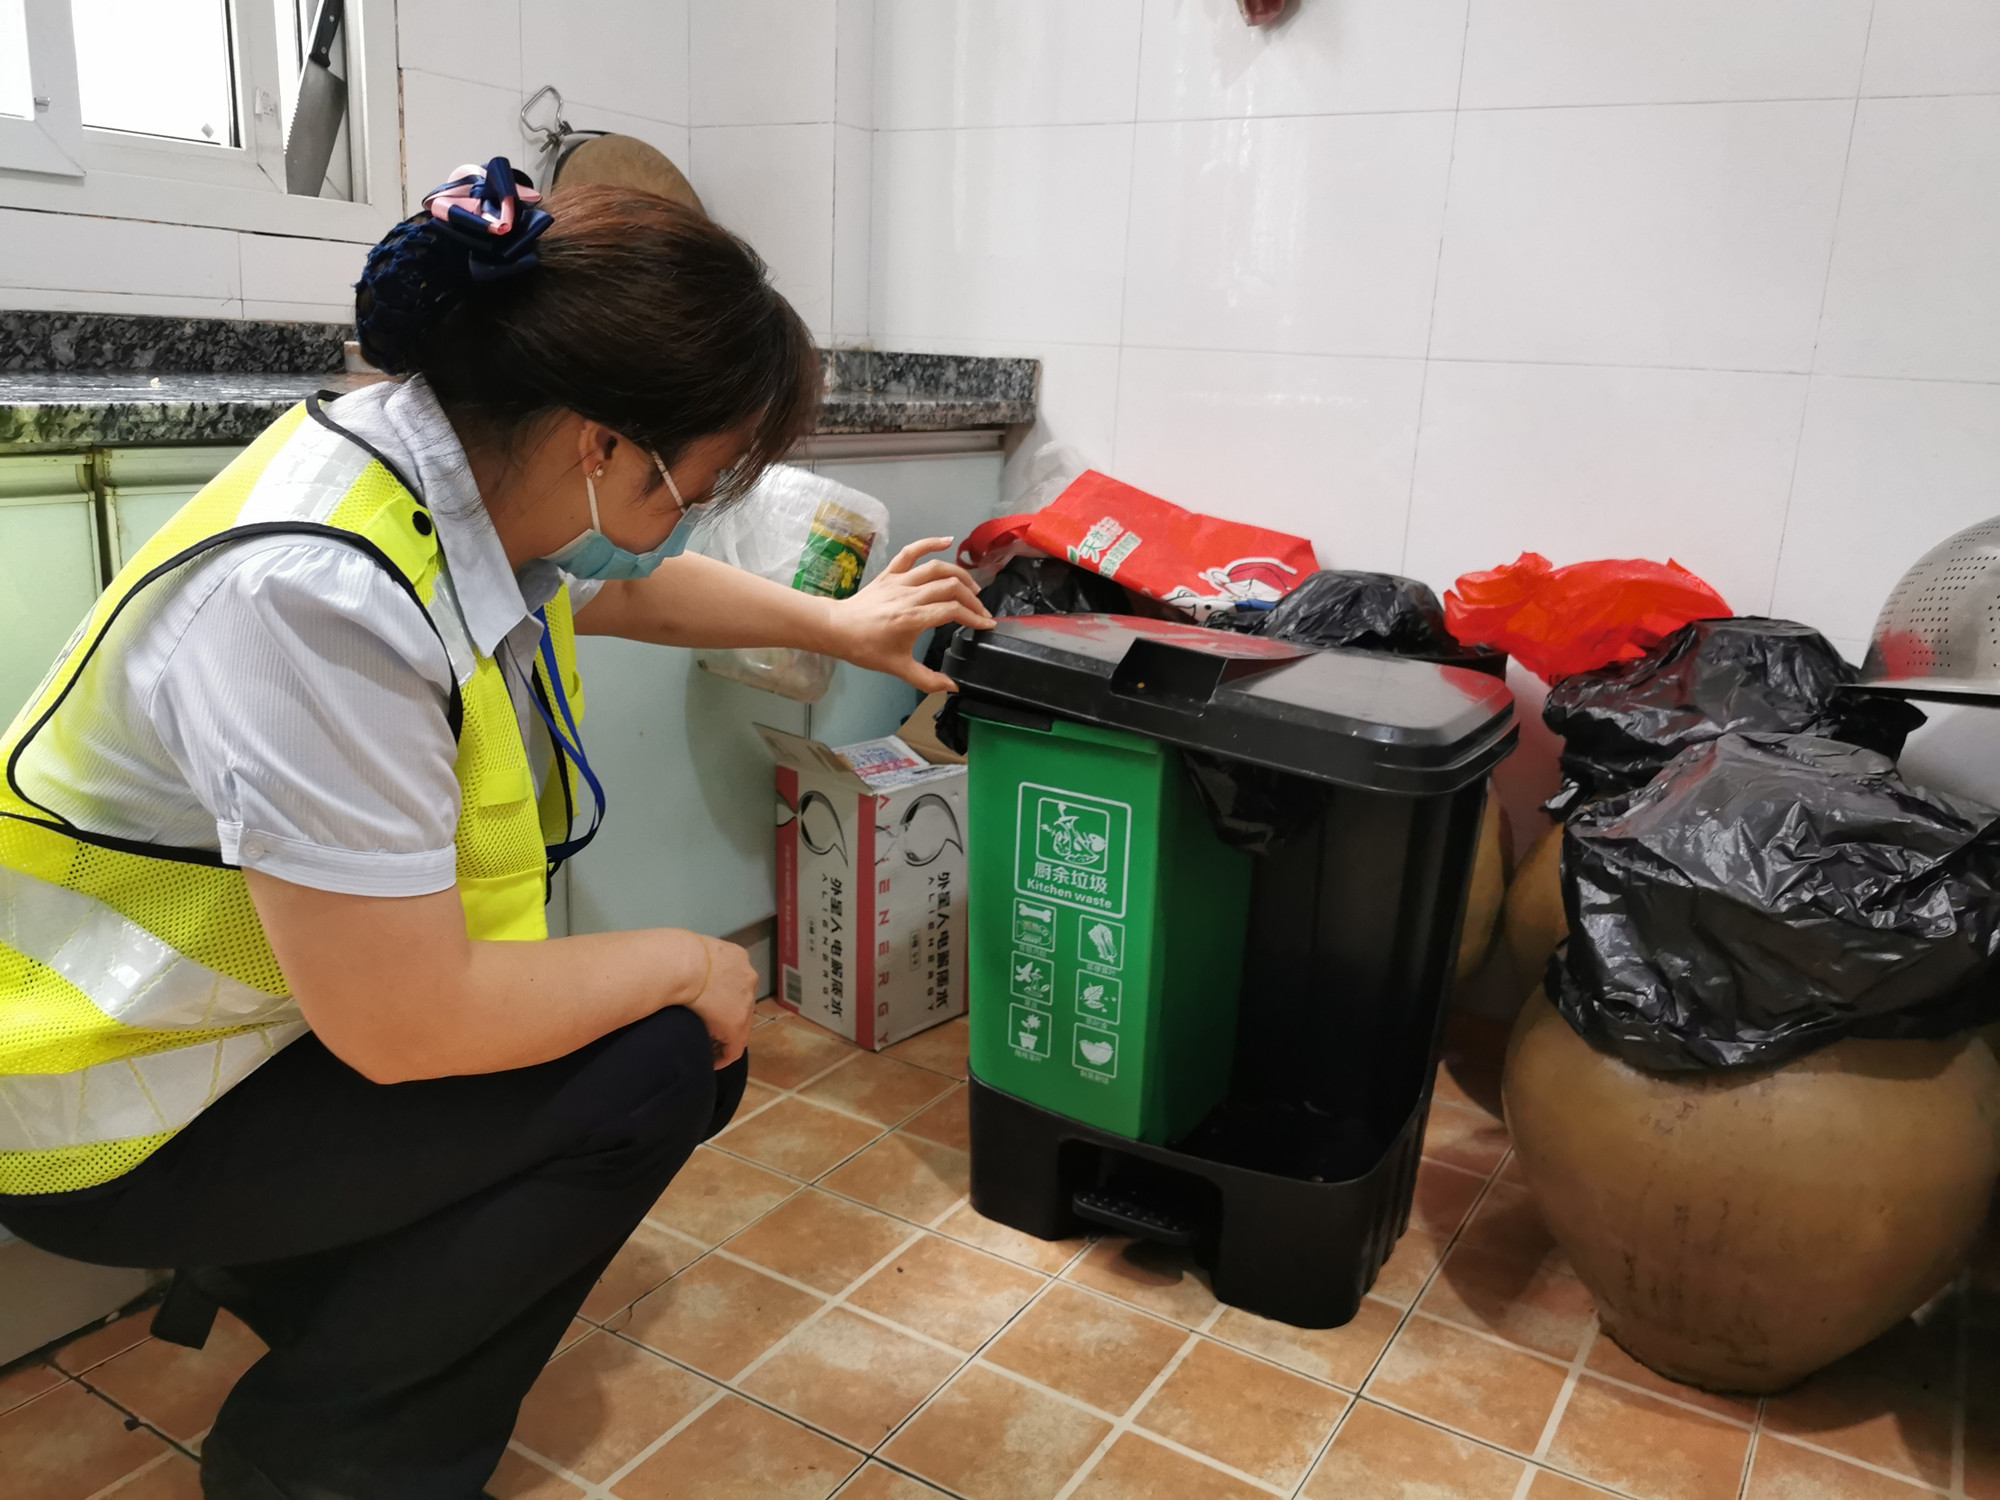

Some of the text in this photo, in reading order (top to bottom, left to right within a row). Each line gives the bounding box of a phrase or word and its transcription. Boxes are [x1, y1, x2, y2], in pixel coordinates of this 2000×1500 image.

[1026, 878, 1112, 909] Kitchen waste
[1034, 861, 1108, 894] 厨余垃圾
[830, 877, 844, 1018] 外星人电解质水
